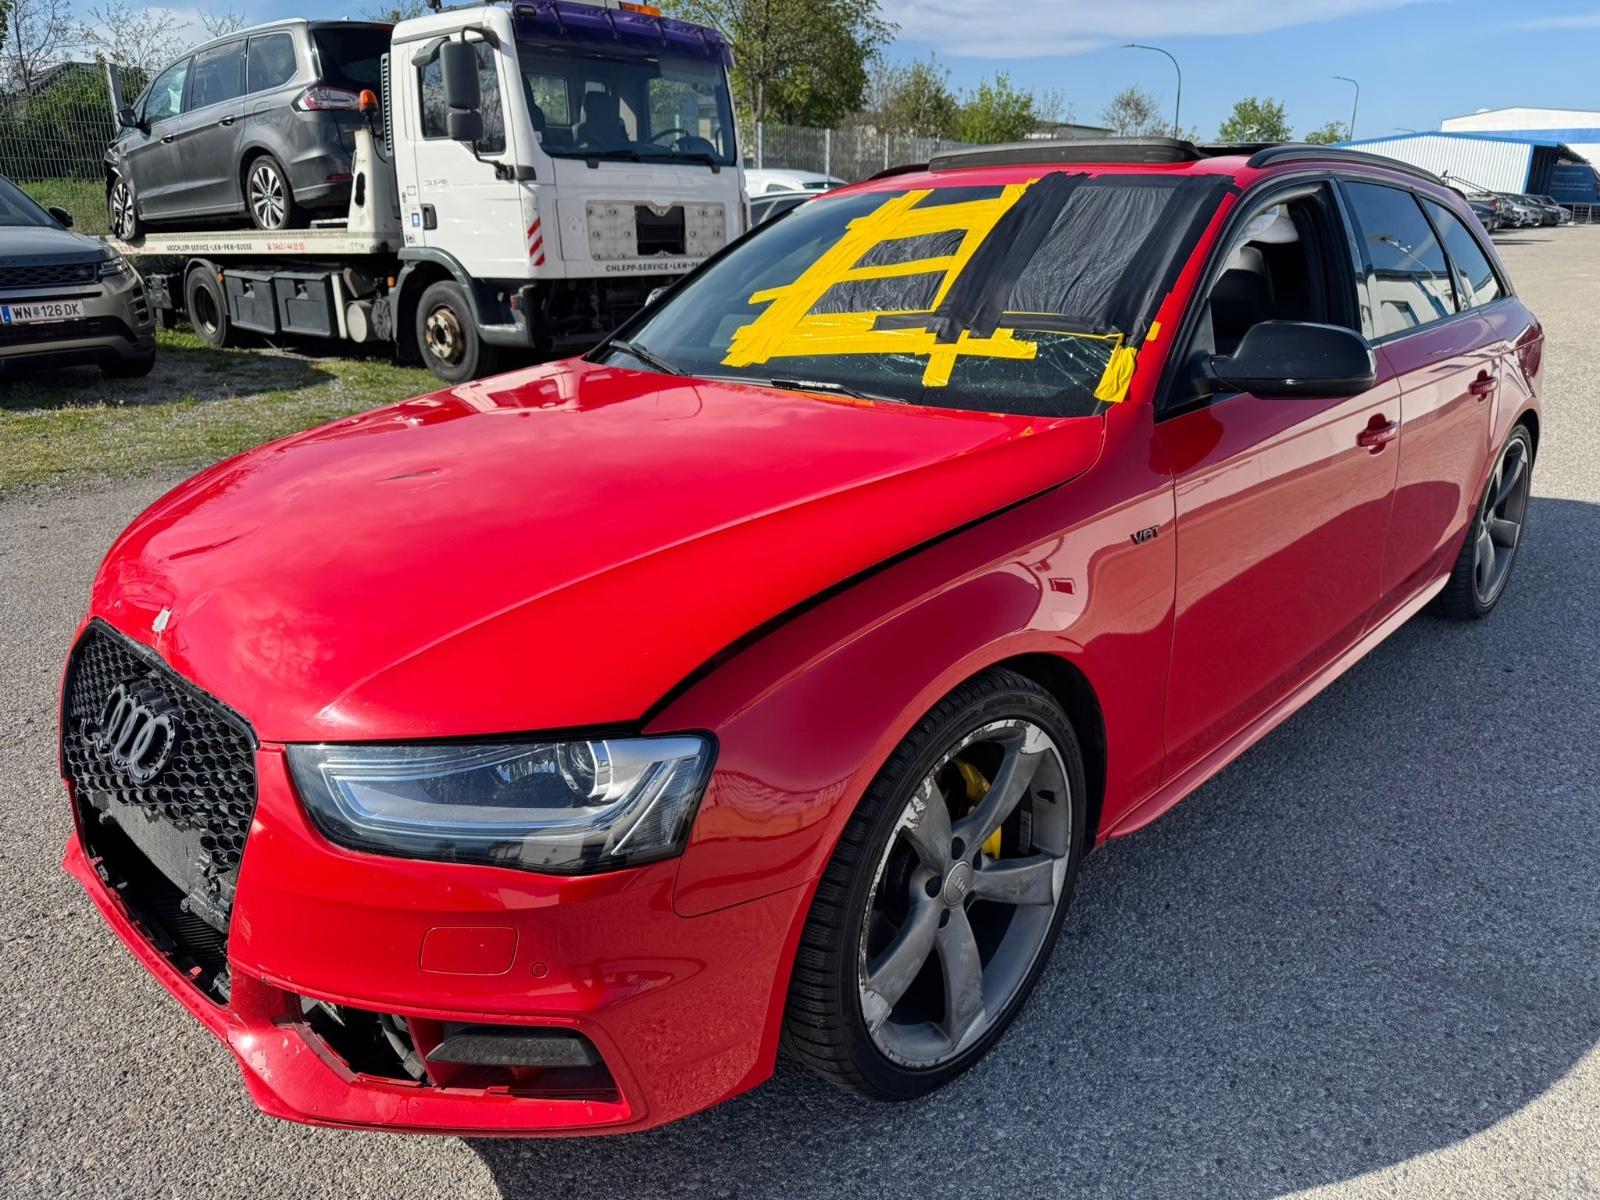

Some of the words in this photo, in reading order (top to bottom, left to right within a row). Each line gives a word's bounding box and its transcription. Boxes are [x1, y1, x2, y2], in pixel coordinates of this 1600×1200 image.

[13, 306, 32, 319] WN
[41, 304, 63, 317] 126
[64, 303, 80, 316] DK
